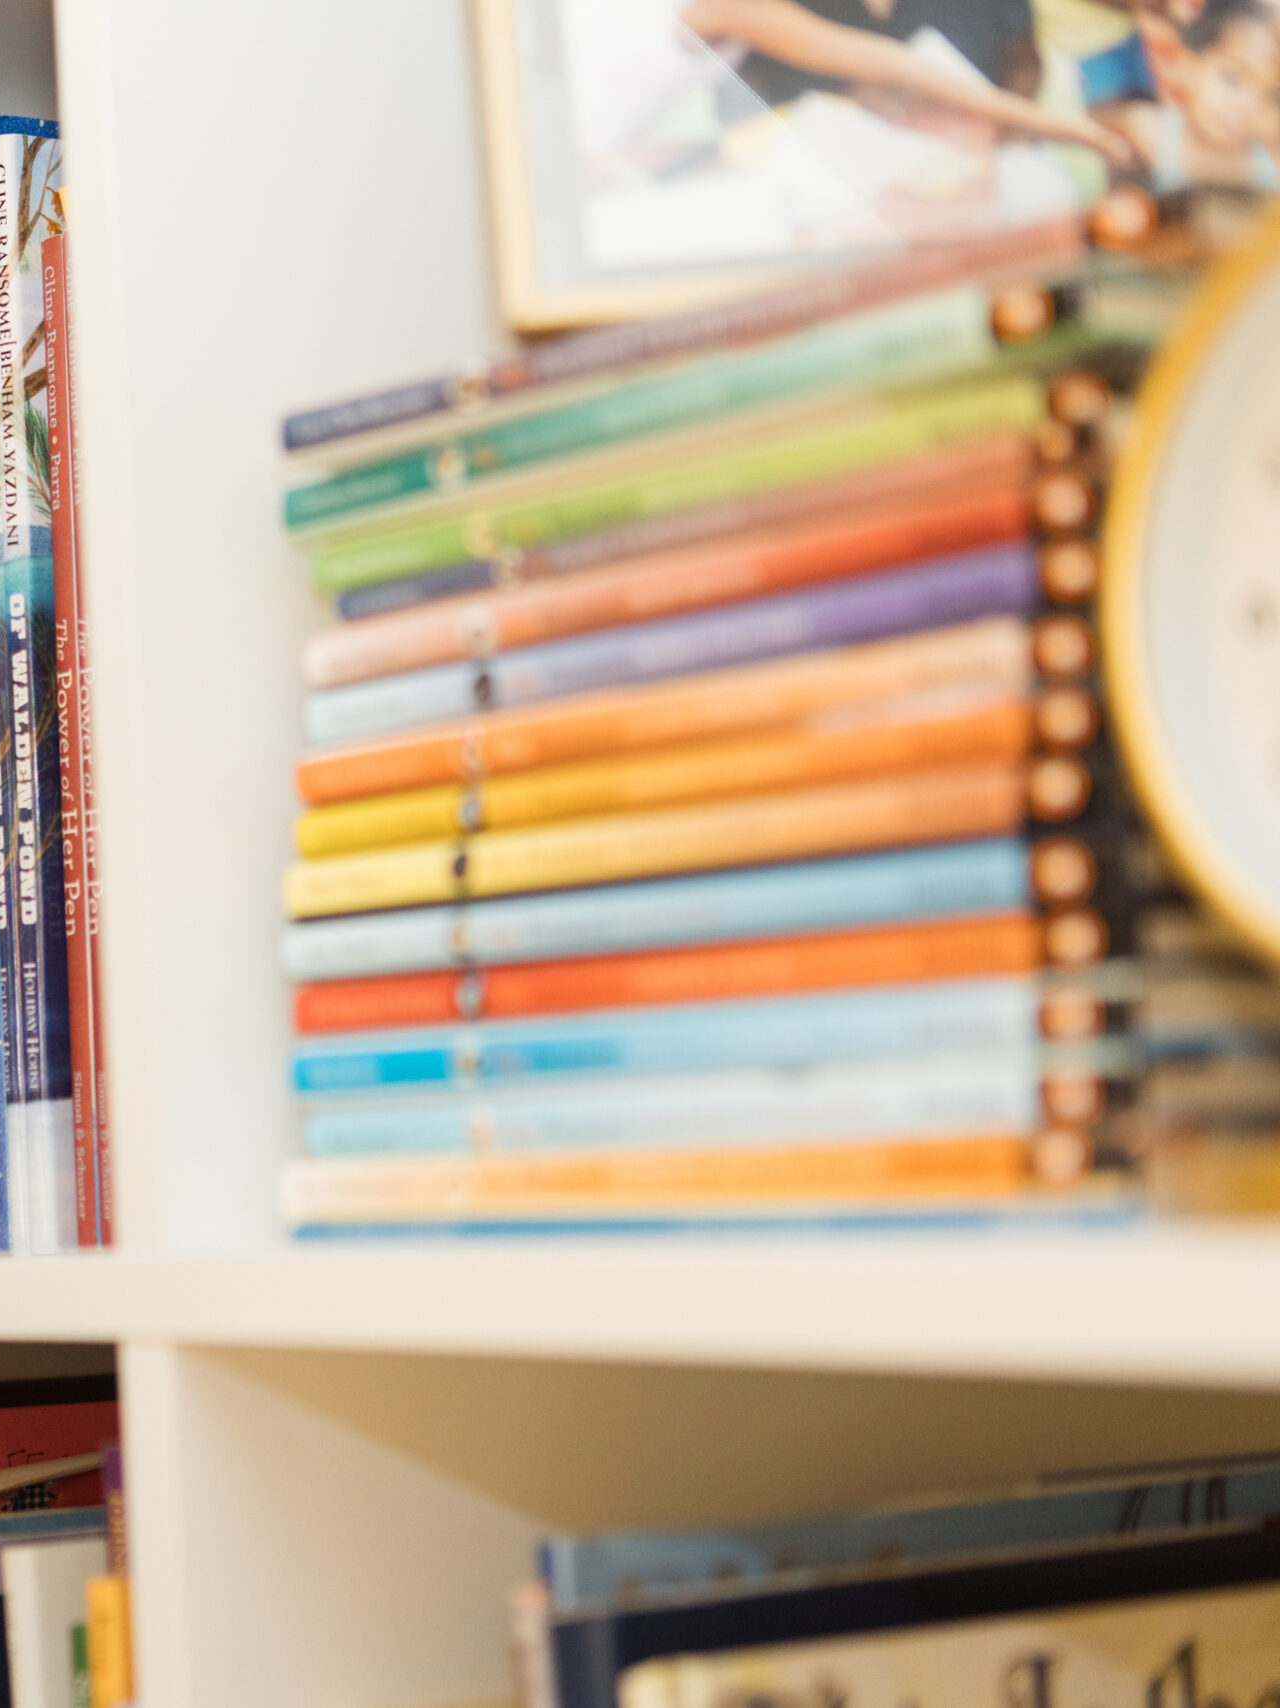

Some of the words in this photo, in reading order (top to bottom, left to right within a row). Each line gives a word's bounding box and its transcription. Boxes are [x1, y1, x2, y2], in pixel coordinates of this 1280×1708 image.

[44, 265, 59, 428] Cline-Ransome
[50, 452, 62, 511] Parra
[9, 593, 27, 640] OF
[55, 618, 69, 662] The
[11, 650, 34, 810] WALDEN
[56, 668, 73, 769] Power
[60, 775, 74, 802] of
[61, 808, 79, 870] Her
[18, 820, 38, 925] POND
[64, 878, 81, 938] Pen
[72, 1071, 84, 1124] Simon
[75, 1146, 87, 1221] Schuster
